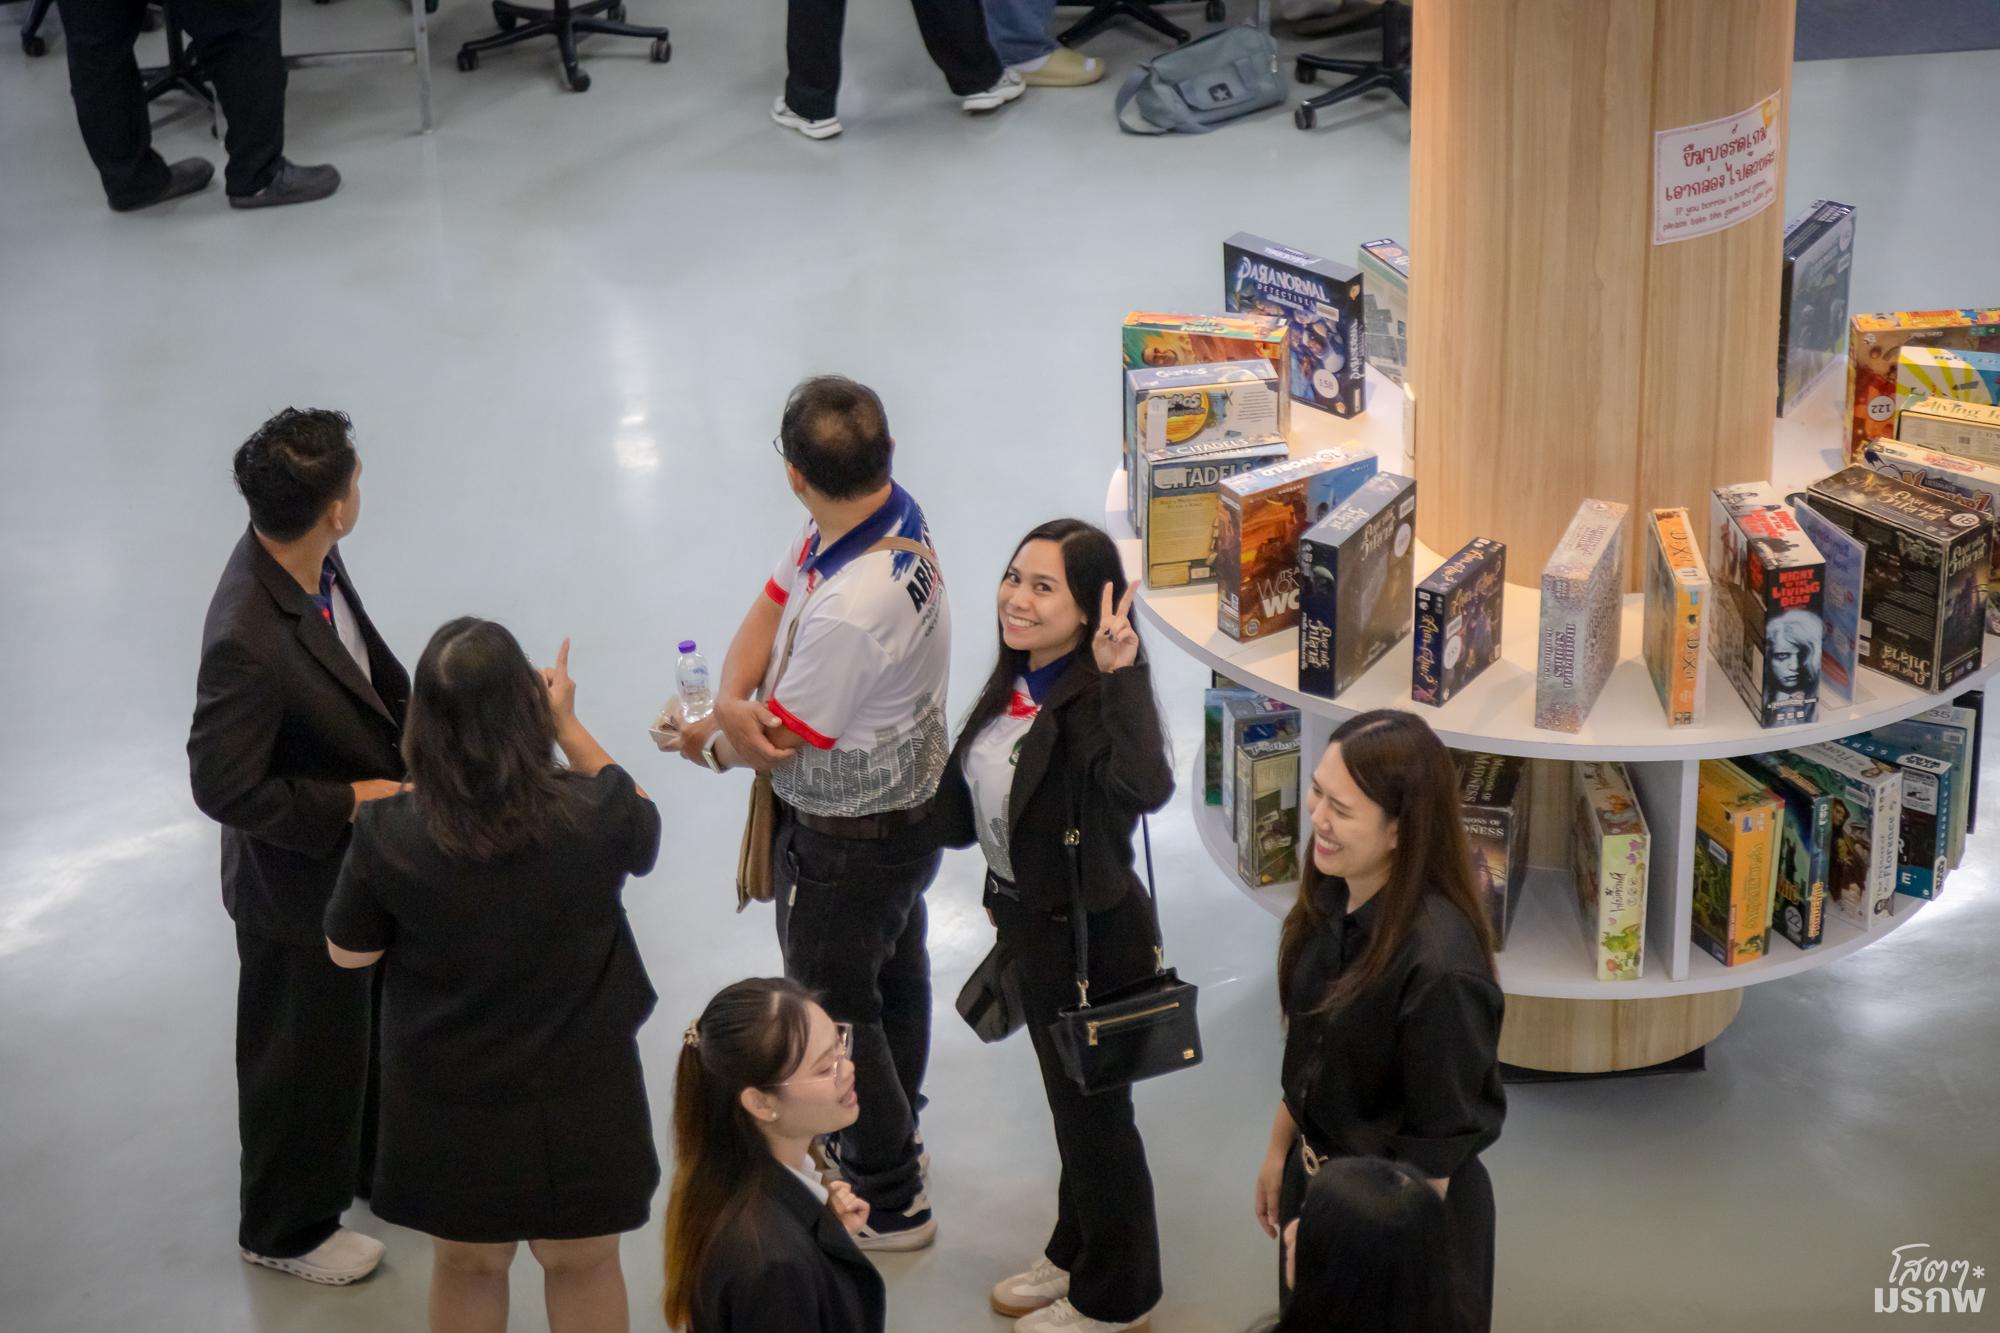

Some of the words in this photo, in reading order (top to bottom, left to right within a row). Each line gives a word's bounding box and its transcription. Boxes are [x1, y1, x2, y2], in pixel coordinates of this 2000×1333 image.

[1236, 256, 1330, 303] PARANORMAL
[1176, 438, 1249, 455] CITADELS
[1956, 514, 1976, 526] 18
